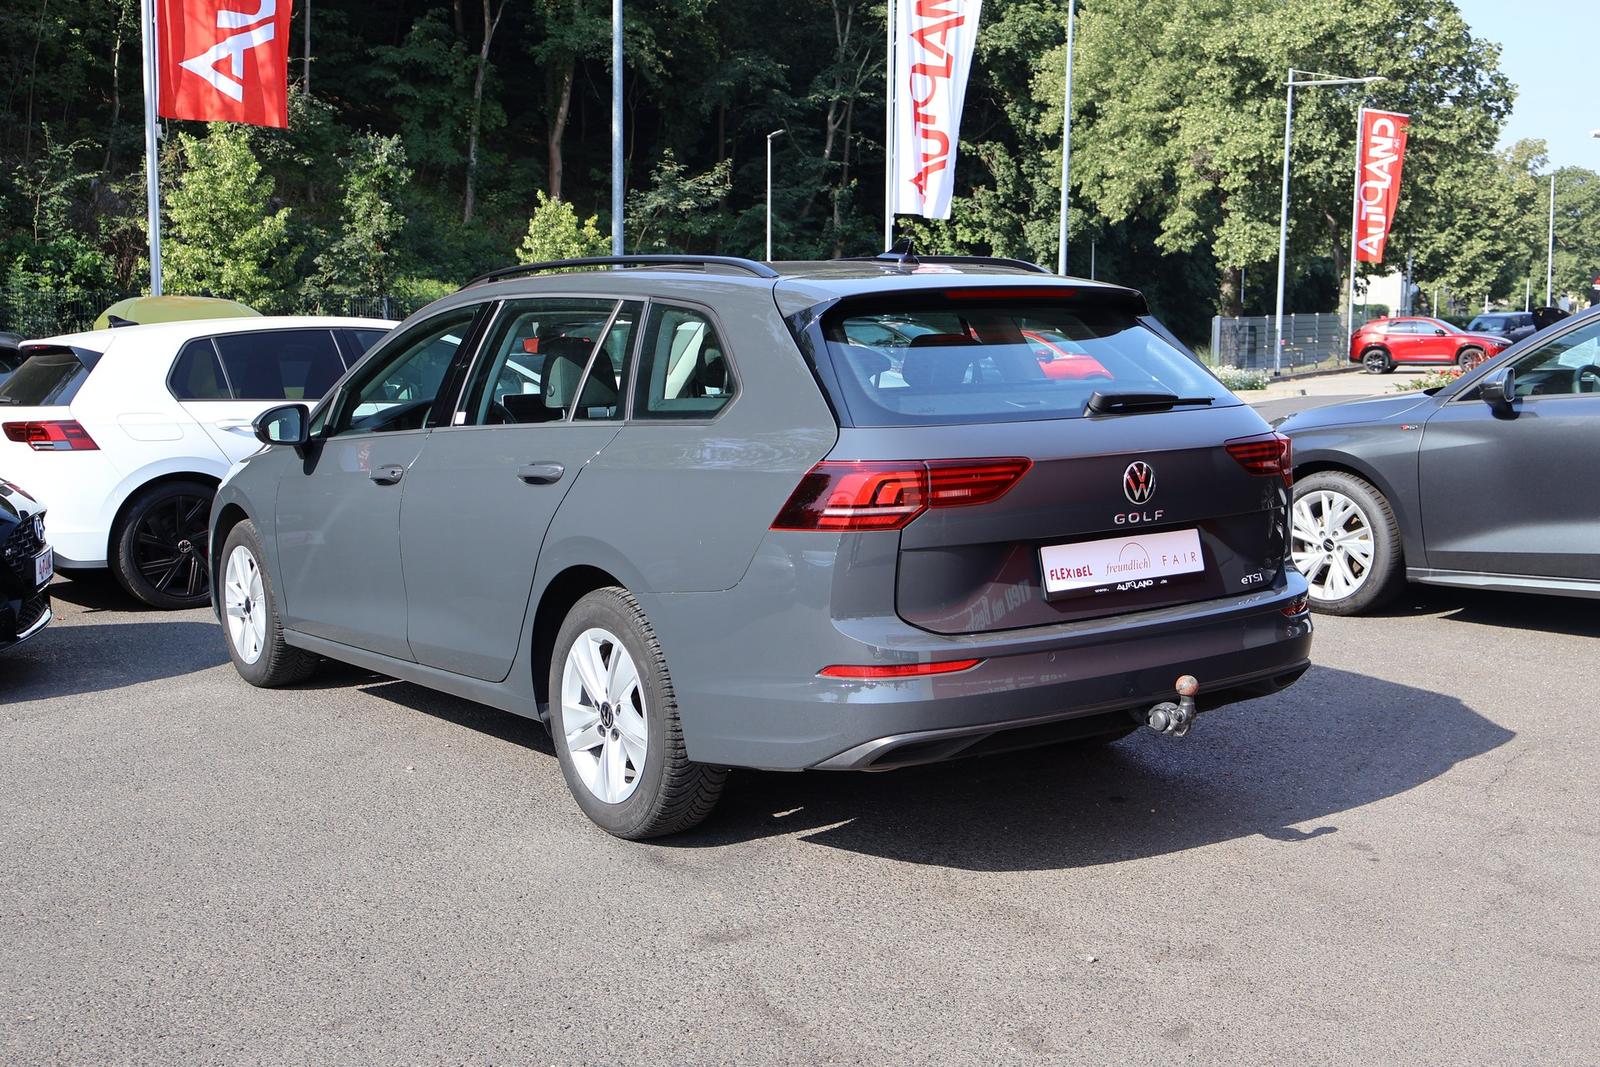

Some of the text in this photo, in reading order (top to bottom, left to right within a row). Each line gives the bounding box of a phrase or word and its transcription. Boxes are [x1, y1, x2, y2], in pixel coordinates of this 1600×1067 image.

[1358, 118, 1399, 256] AUTOLAND
[1114, 509, 1164, 525] GOLF
[1050, 551, 1197, 581] FLEXIBEL freundlich FAIR
[1116, 580, 1153, 591] AUTOLAND
[1241, 572, 1263, 585] eTSI
